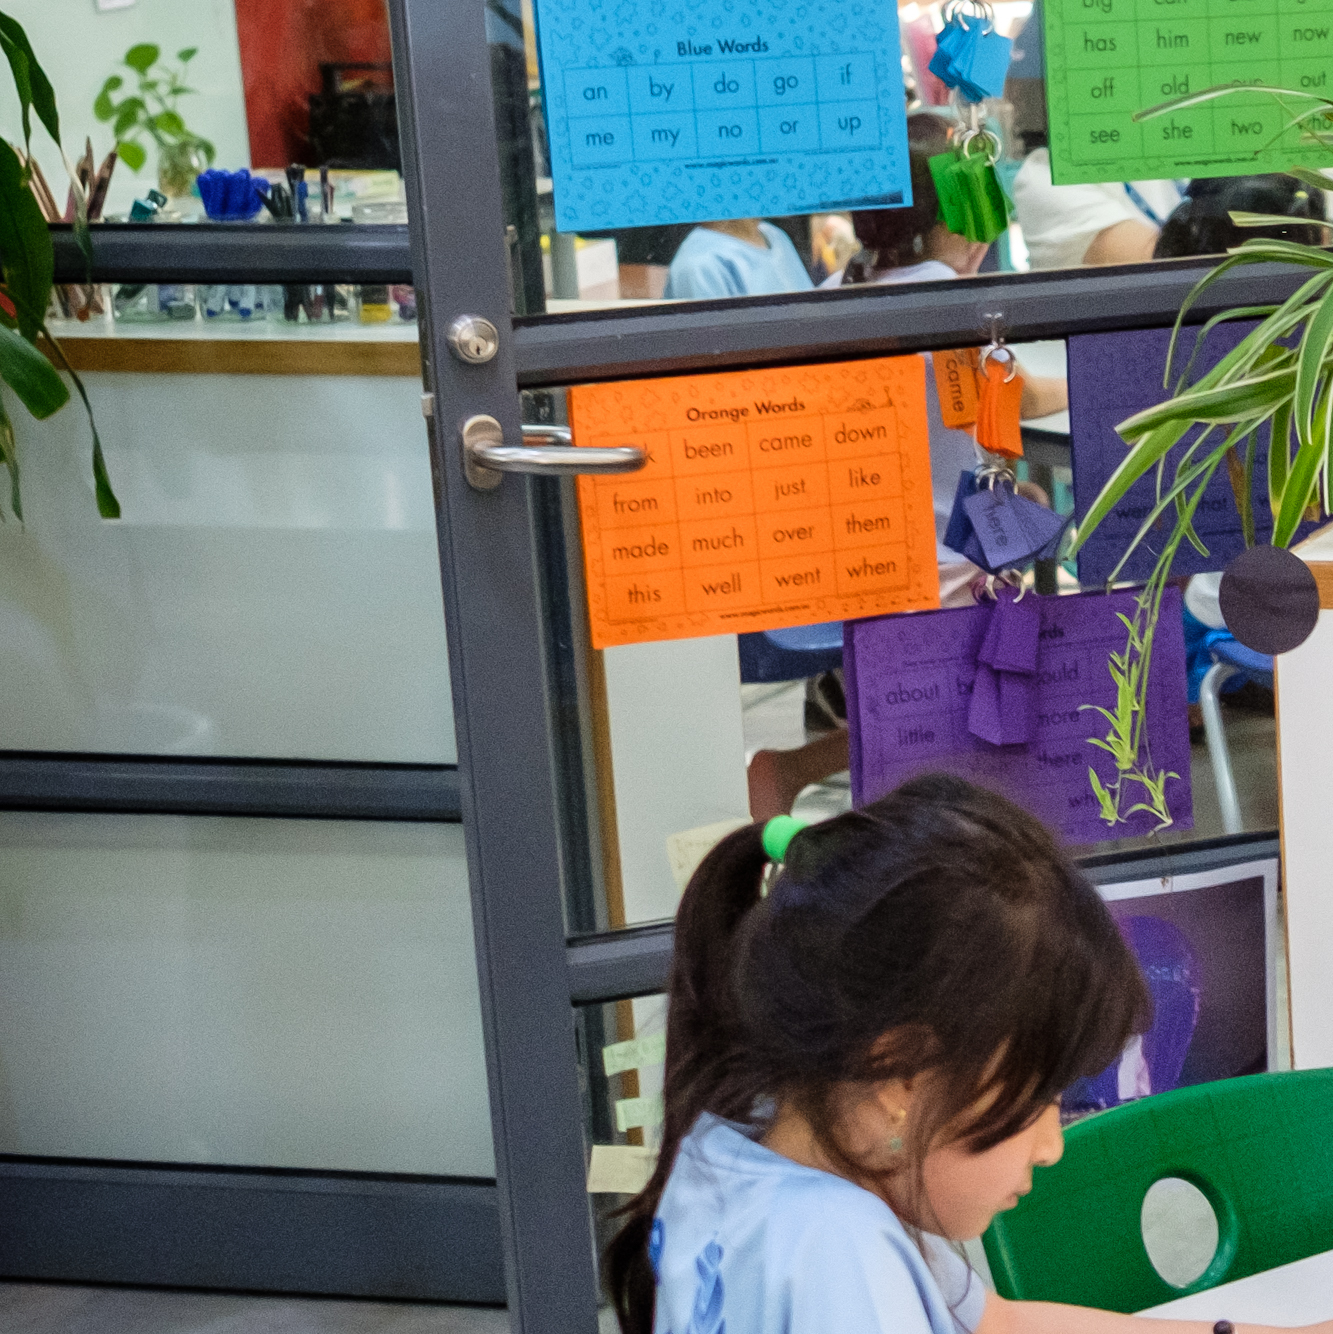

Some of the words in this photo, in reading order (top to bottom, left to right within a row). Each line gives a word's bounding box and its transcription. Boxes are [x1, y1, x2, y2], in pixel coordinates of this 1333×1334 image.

[676, 40, 712, 56] Blue
[719, 38, 769, 55] Words
[1083, 32, 1116, 52] has
[1156, 29, 1189, 48] him
[1225, 29, 1261, 45] new
[1293, 26, 1329, 42] now
[580, 84, 608, 101] an
[649, 76, 674, 101] by
[714, 71, 739, 94] do
[773, 74, 799, 95] go
[839, 62, 853, 84] if
[1091, 78, 1115, 99] off
[1161, 75, 1190, 96] old
[1301, 71, 1326, 87] out
[586, 130, 614, 147] me
[651, 126, 680, 146] my
[718, 124, 742, 138] no
[779, 119, 798, 134] or
[838, 114, 861, 136] up
[1090, 129, 1120, 144] see
[1162, 119, 1193, 140] she
[1231, 120, 1262, 135] two
[1298, 114, 1332, 130] ho
[946, 358, 965, 413] came
[686, 406, 749, 423] Orange
[754, 399, 806, 416] Words
[683, 438, 734, 460] been
[759, 434, 813, 452] came
[834, 422, 888, 445] down
[612, 493, 659, 514] from
[695, 486, 733, 505] into
[774, 479, 807, 501] just
[848, 468, 881, 488] like
[612, 540, 670, 561] made
[692, 527, 744, 552] much
[772, 525, 815, 543] over
[845, 515, 891, 534] them
[627, 585, 662, 604] this
[702, 573, 742, 597] well
[774, 568, 821, 587] went
[845, 557, 897, 577] when
[885, 683, 940, 706] about
